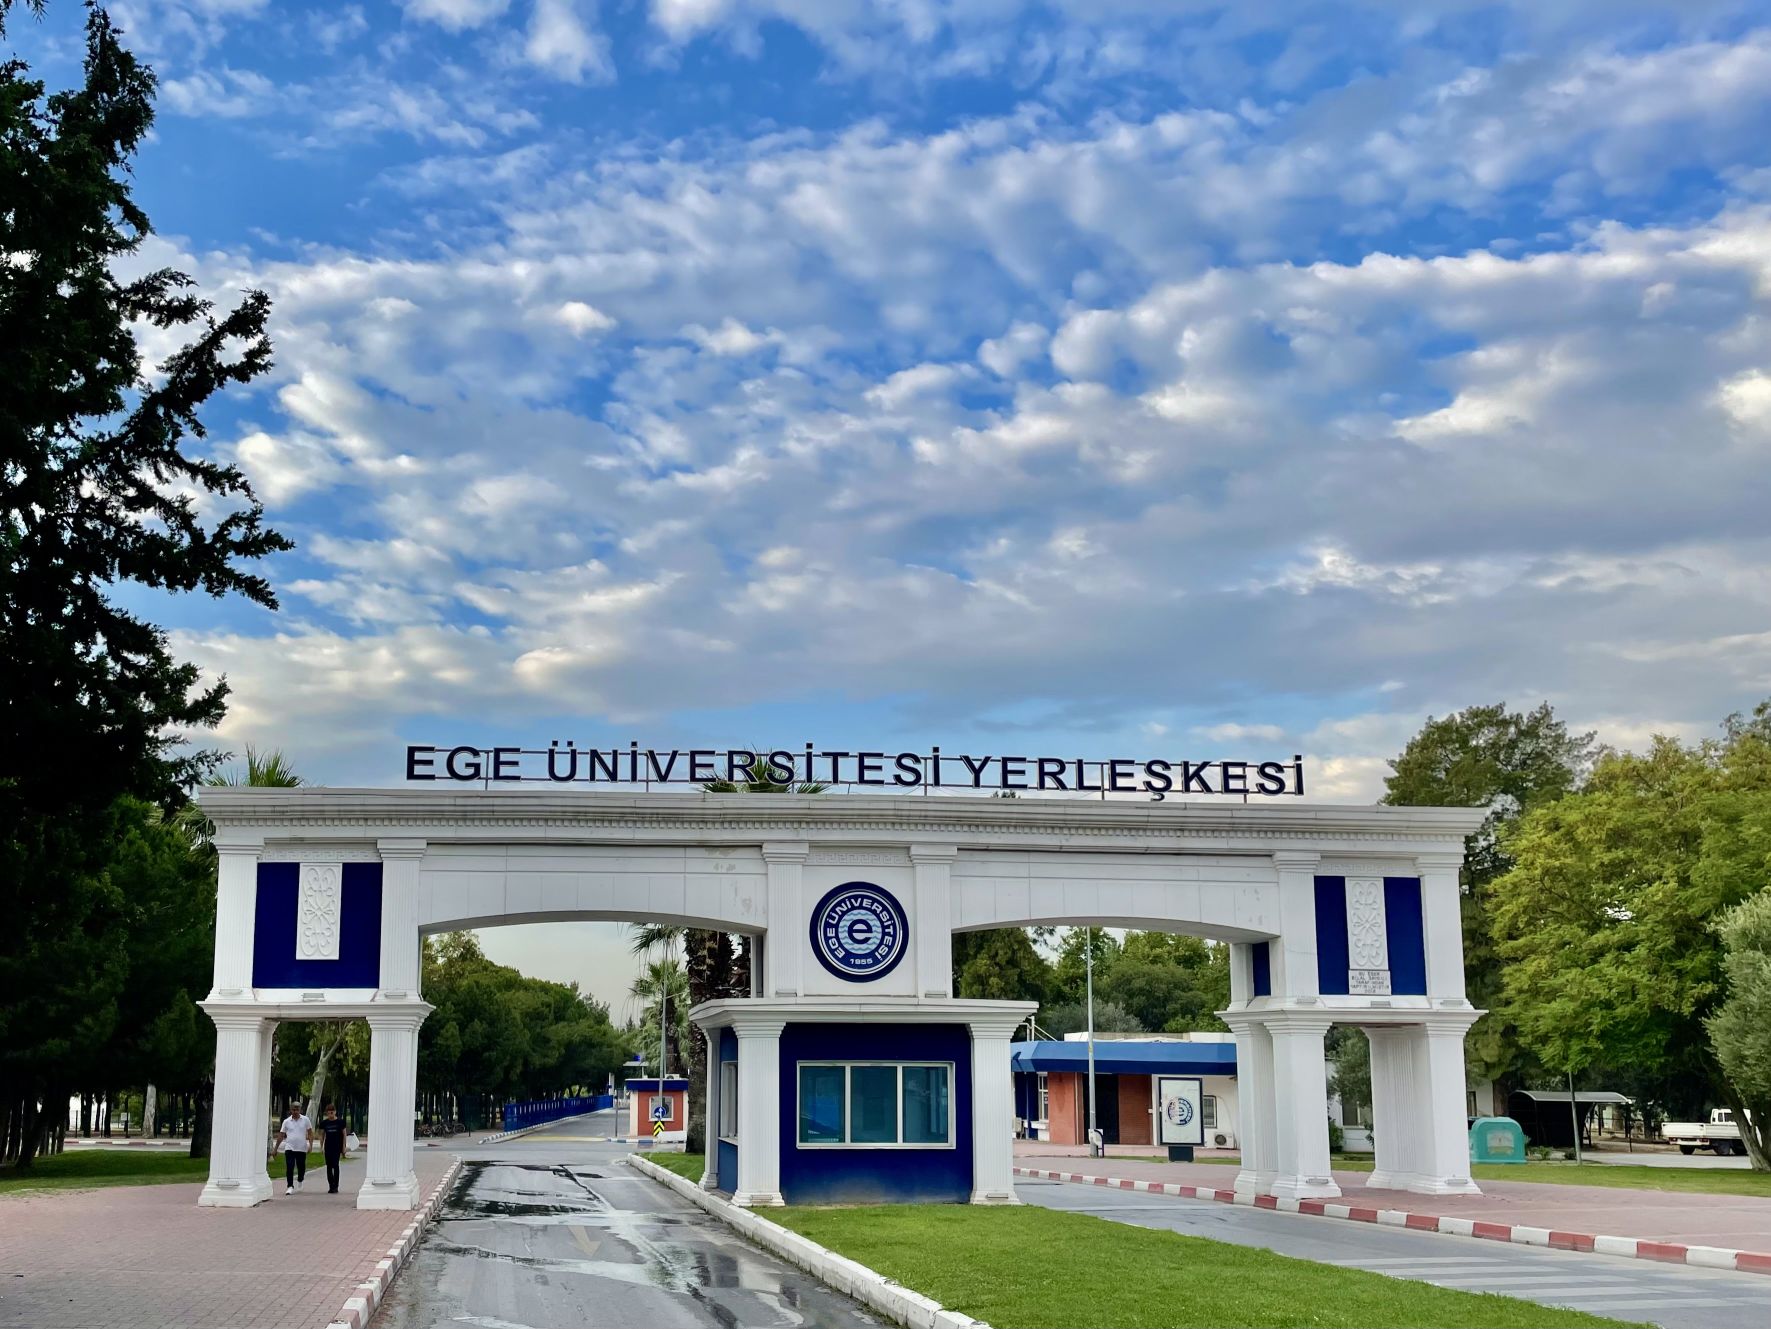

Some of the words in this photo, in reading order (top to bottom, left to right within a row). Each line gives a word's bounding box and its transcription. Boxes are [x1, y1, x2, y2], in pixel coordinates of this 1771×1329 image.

[406, 746, 521, 781] EGE
[547, 740, 940, 787] ÜNİVERSİTESİ
[960, 754, 1304, 801] YERLEŞKESİ
[827, 898, 893, 960] ÜNİVERSİTESİ
[827, 928, 845, 958] EGE
